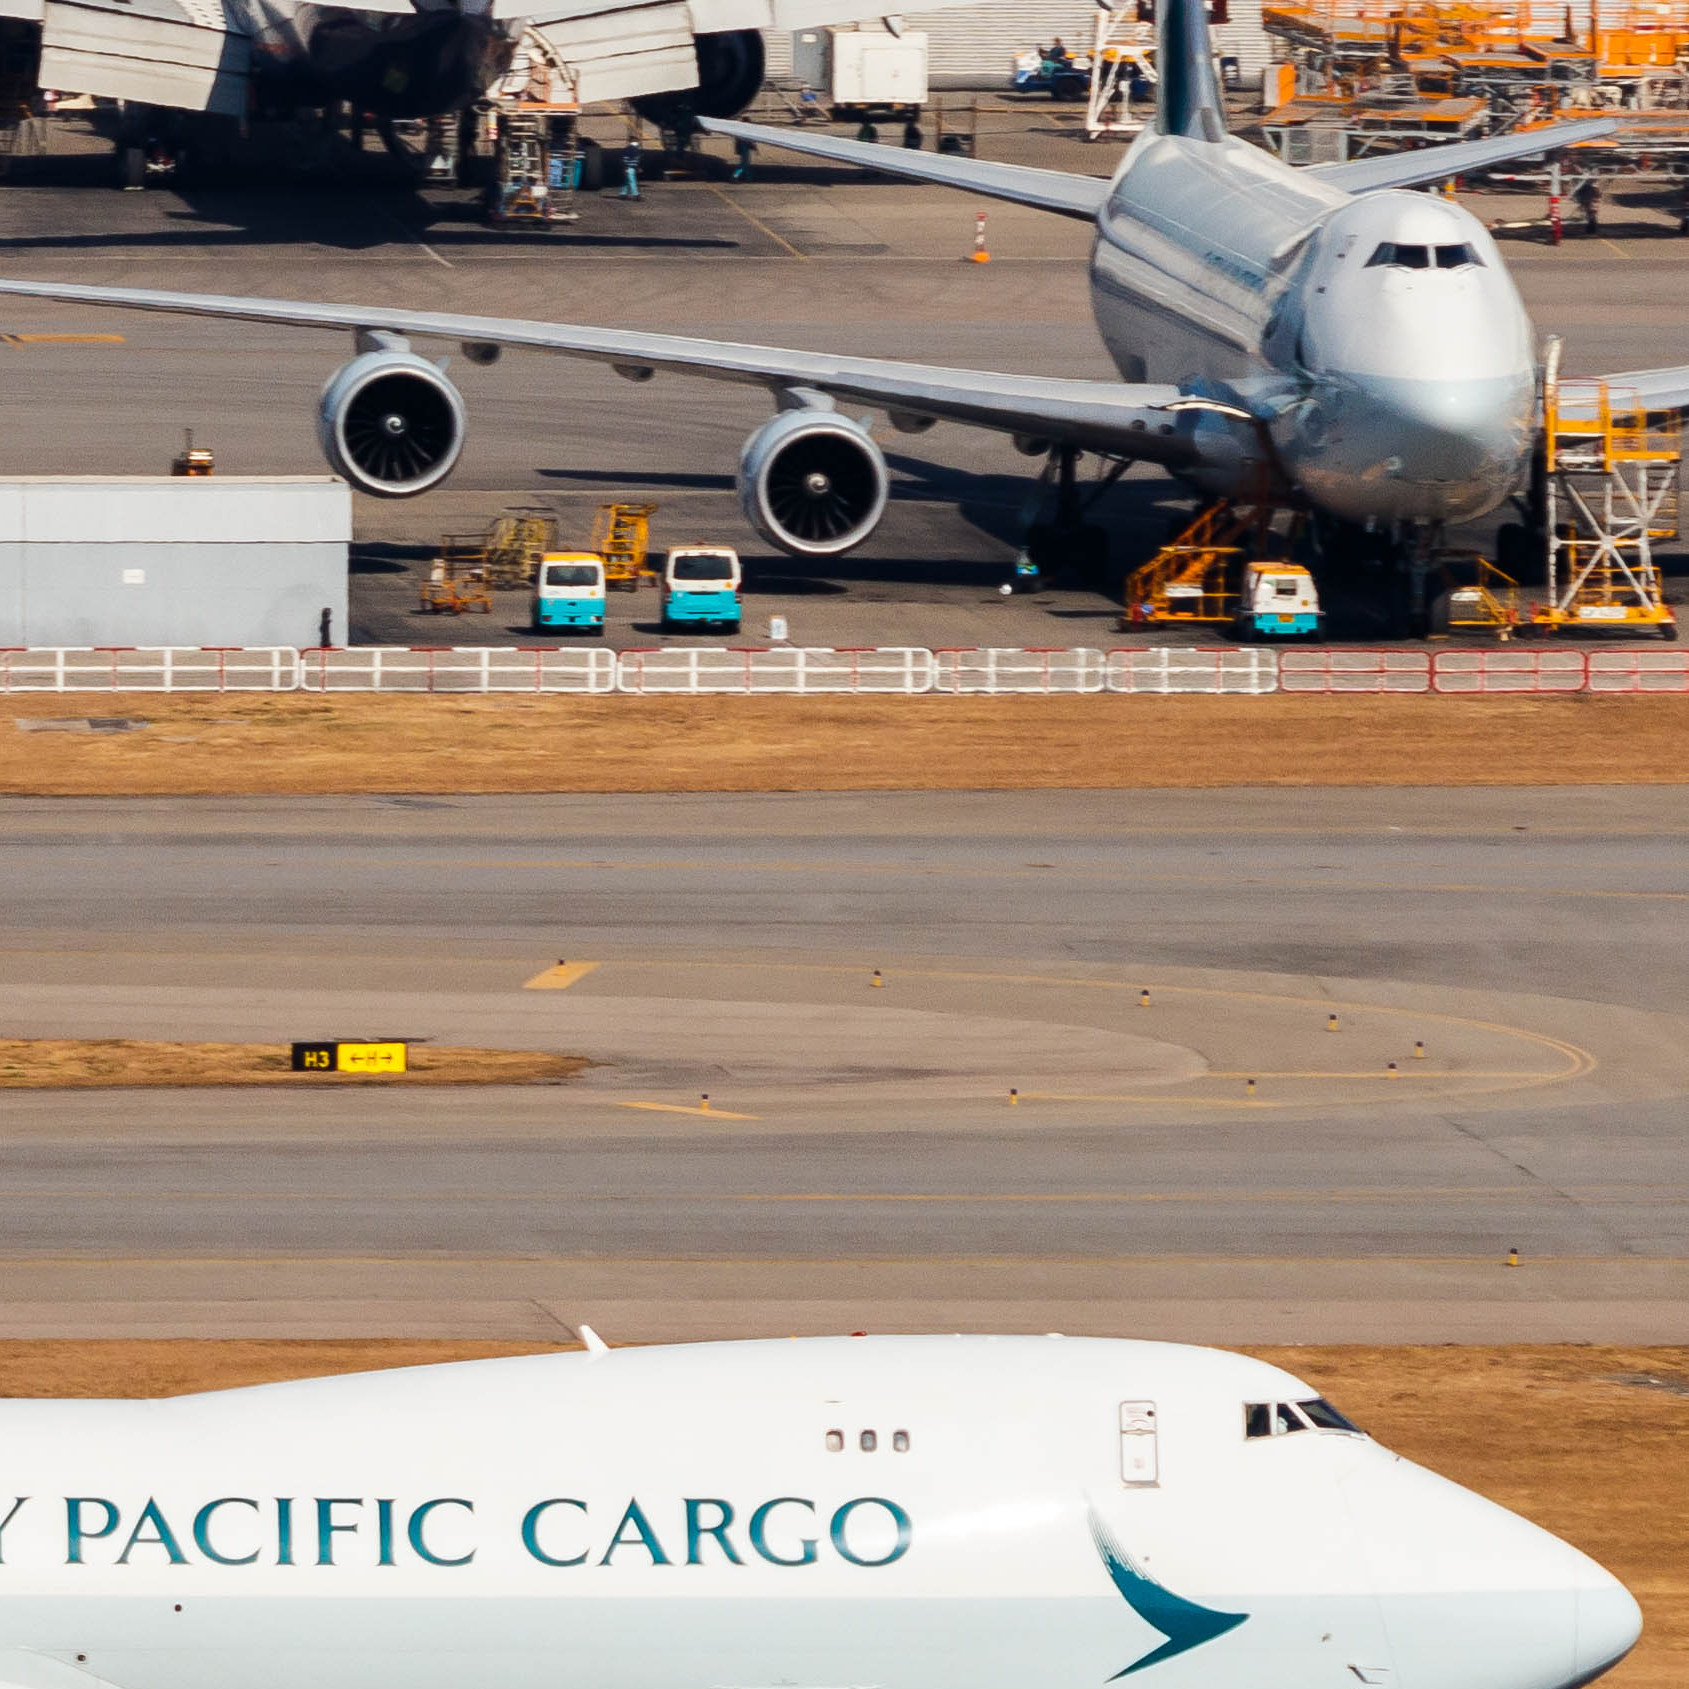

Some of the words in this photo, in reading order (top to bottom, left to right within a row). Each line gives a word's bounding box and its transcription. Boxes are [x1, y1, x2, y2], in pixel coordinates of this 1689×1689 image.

[304, 1051, 330, 1067] H3
[63, 1496, 476, 1567] PACIFIC
[520, 1496, 912, 1568] CARGO
